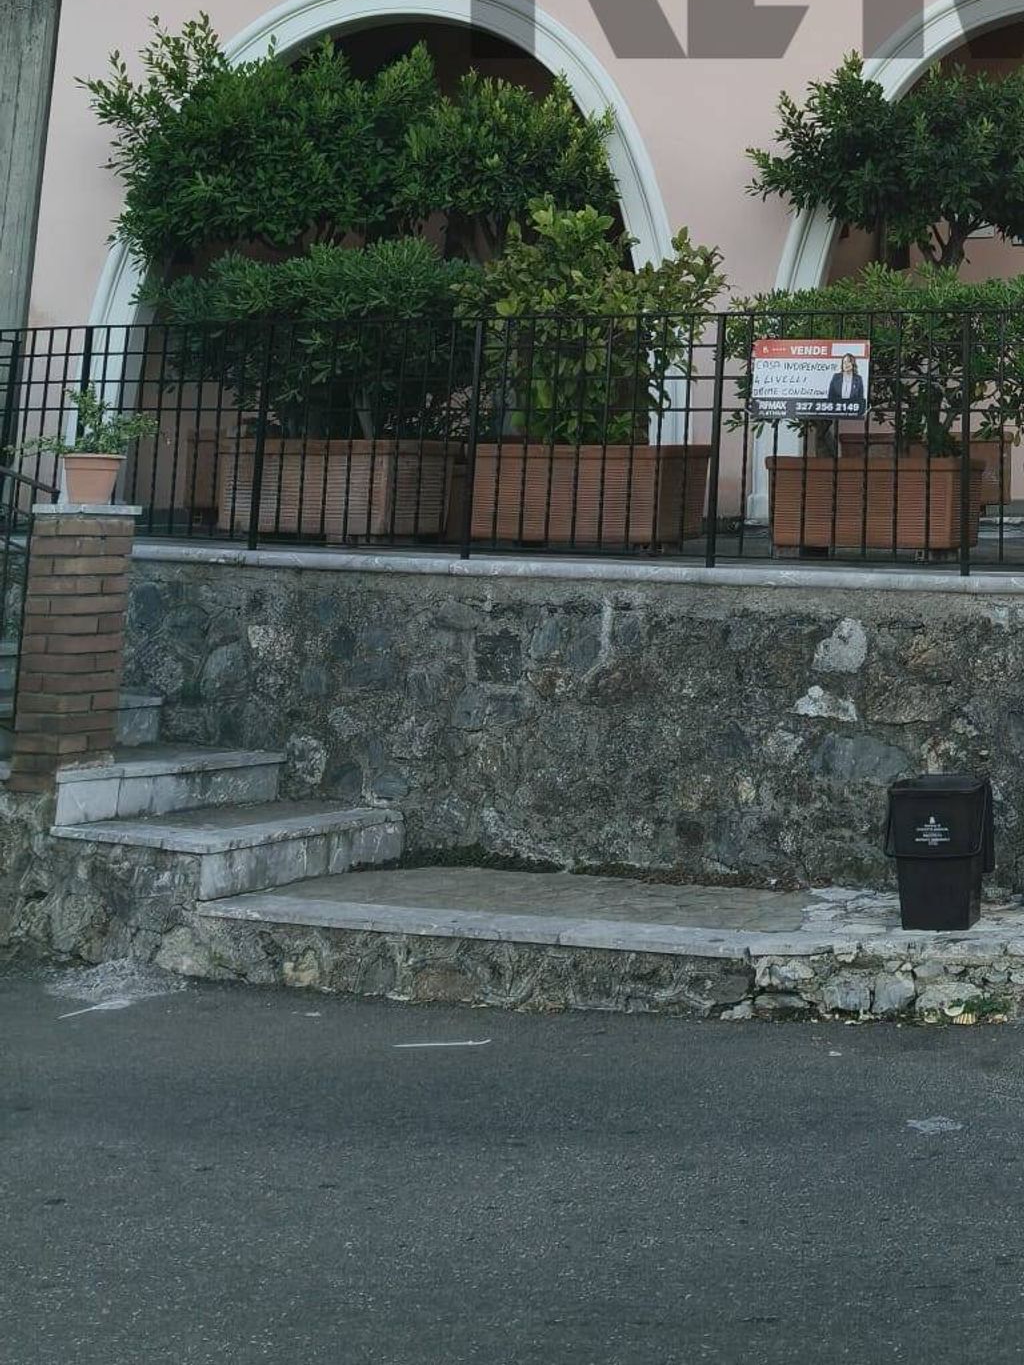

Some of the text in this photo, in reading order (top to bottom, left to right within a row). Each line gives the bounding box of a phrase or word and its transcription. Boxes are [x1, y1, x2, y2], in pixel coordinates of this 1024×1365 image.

[789, 346, 828, 355] VENDE
[795, 402, 812, 411] 327
[815, 402, 834, 411] 256
[835, 402, 860, 411] 2149
